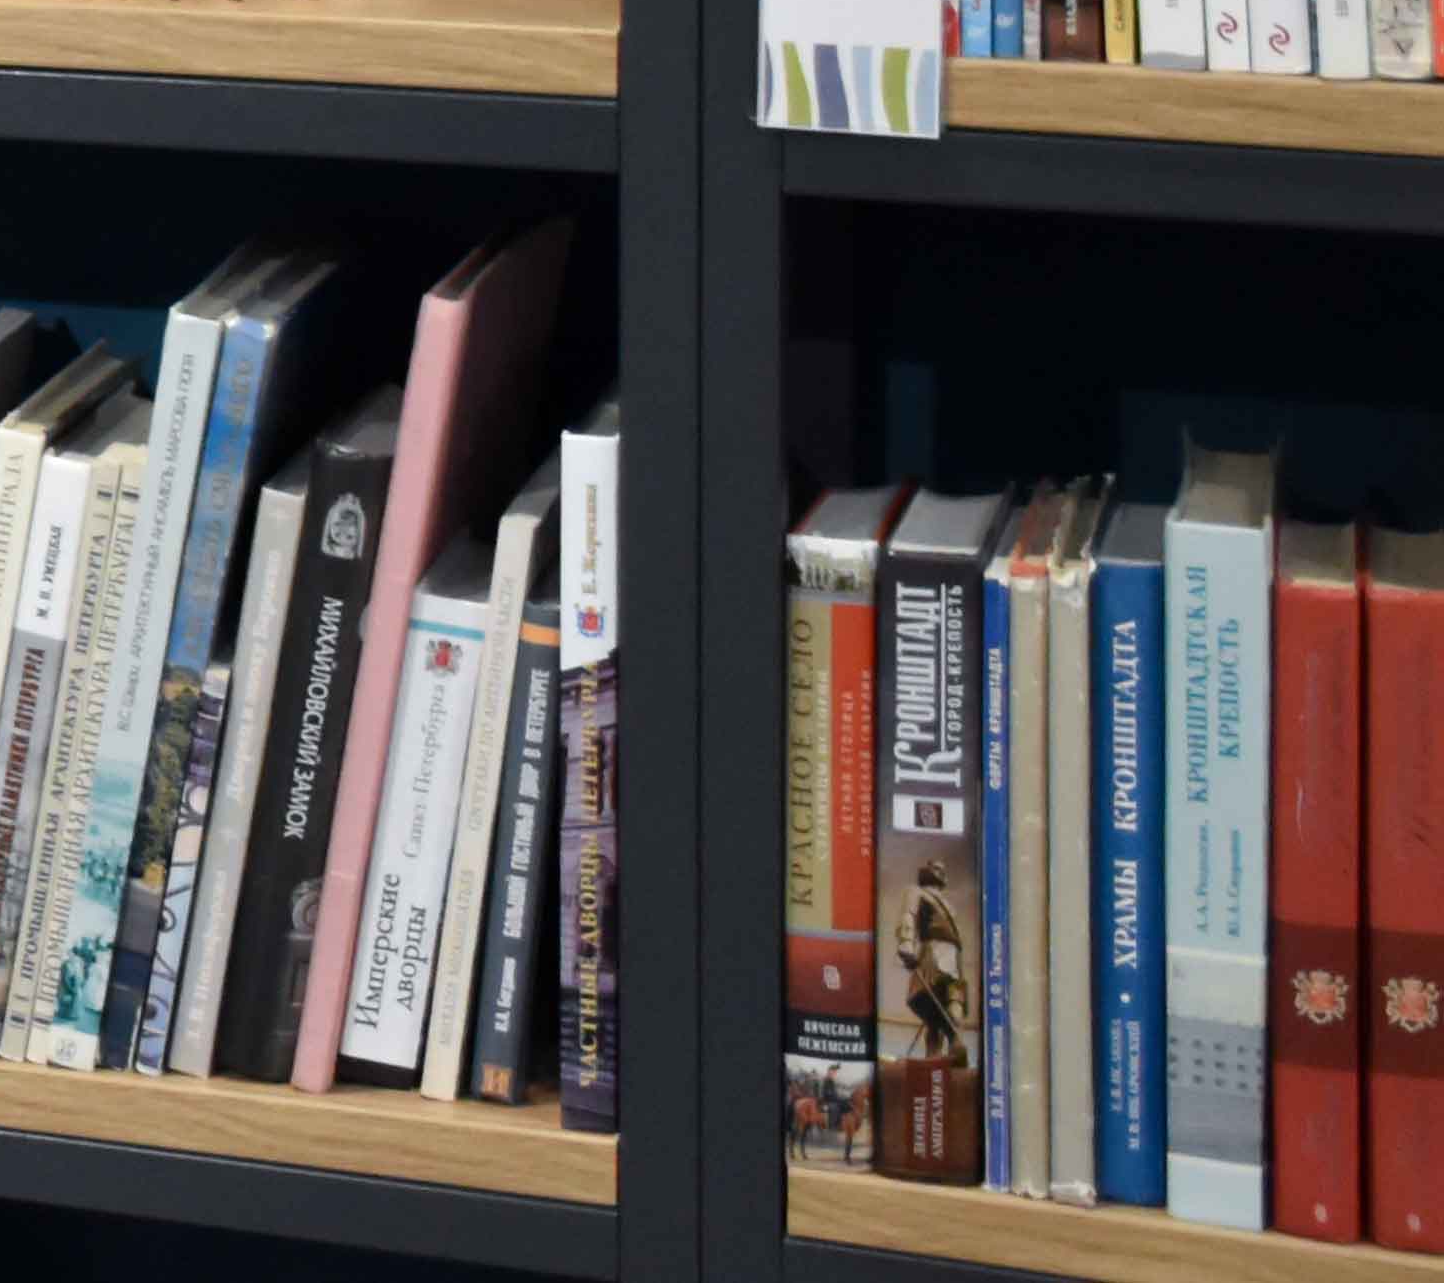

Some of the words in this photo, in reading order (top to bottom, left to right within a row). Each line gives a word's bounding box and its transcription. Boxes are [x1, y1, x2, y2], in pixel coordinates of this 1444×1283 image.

[300, 595, 345, 765] МИХАЙЛОВСКИЙ
[579, 661, 601, 821] ПЕТЕРБУРГА
[788, 617, 815, 718] СЕЛО
[892, 581, 963, 788] КРОНШТАДТ
[946, 583, 966, 744] ГОРОД-КРЕПОСТЬ
[1112, 619, 1141, 831] КРОНШТАДТА
[1187, 566, 1210, 804] КРОНШТАДТСКАЯ
[1217, 618, 1241, 760] КРЕПОСТЬ
[18, 813, 60, 980] ПРОМЫШЛЕННАЯ
[47, 667, 86, 801] АРХИТЕКТУРА
[70, 533, 108, 655] ПЕТЕРБУРГА
[283, 770, 312, 838] ЗАМОК
[399, 683, 448, 859] Санкт-Петербурга
[789, 732, 816, 908] КРАСНОЕ
[353, 873, 401, 1031] Имперские
[394, 905, 428, 1012] дворцы
[579, 834, 602, 944] ДВОРЦЫ
[1112, 859, 1138, 969] ХРАМЫ
[578, 958, 599, 1087] ЧАСТНЫЕ
